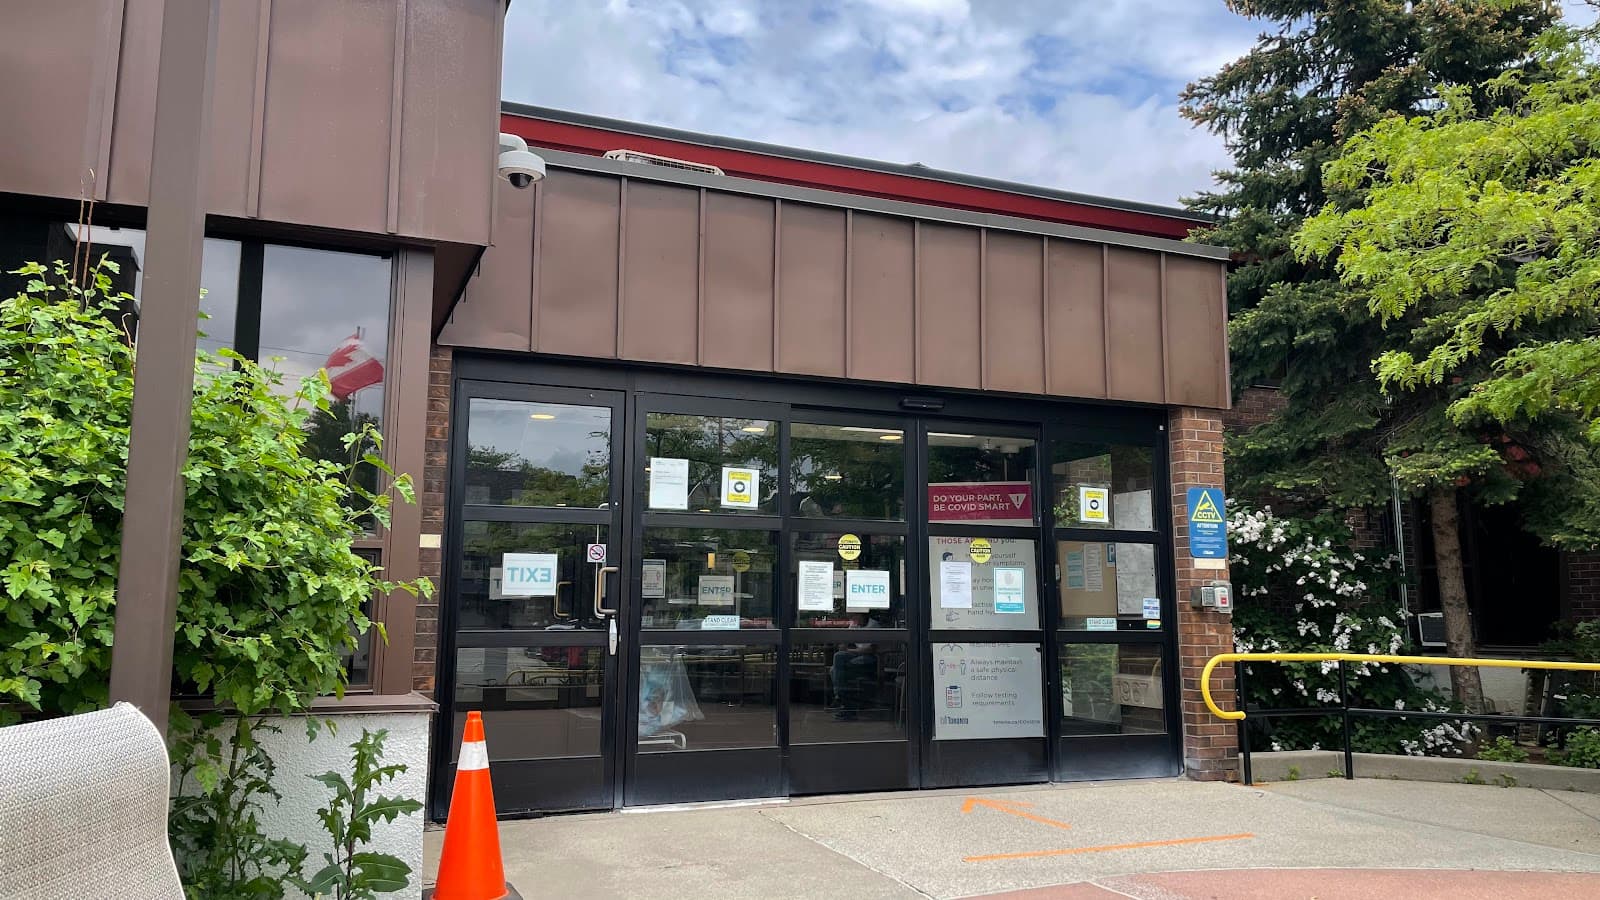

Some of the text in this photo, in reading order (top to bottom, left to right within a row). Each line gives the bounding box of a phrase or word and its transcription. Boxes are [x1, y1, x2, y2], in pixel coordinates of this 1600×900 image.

[949, 494, 977, 502] YOUR
[978, 494, 1002, 502] PART,
[933, 502, 1010, 512] BE COVID SMART
[1197, 511, 1216, 519] CCTV
[851, 584, 886, 594] ENTER
[994, 692, 1018, 700] testing
